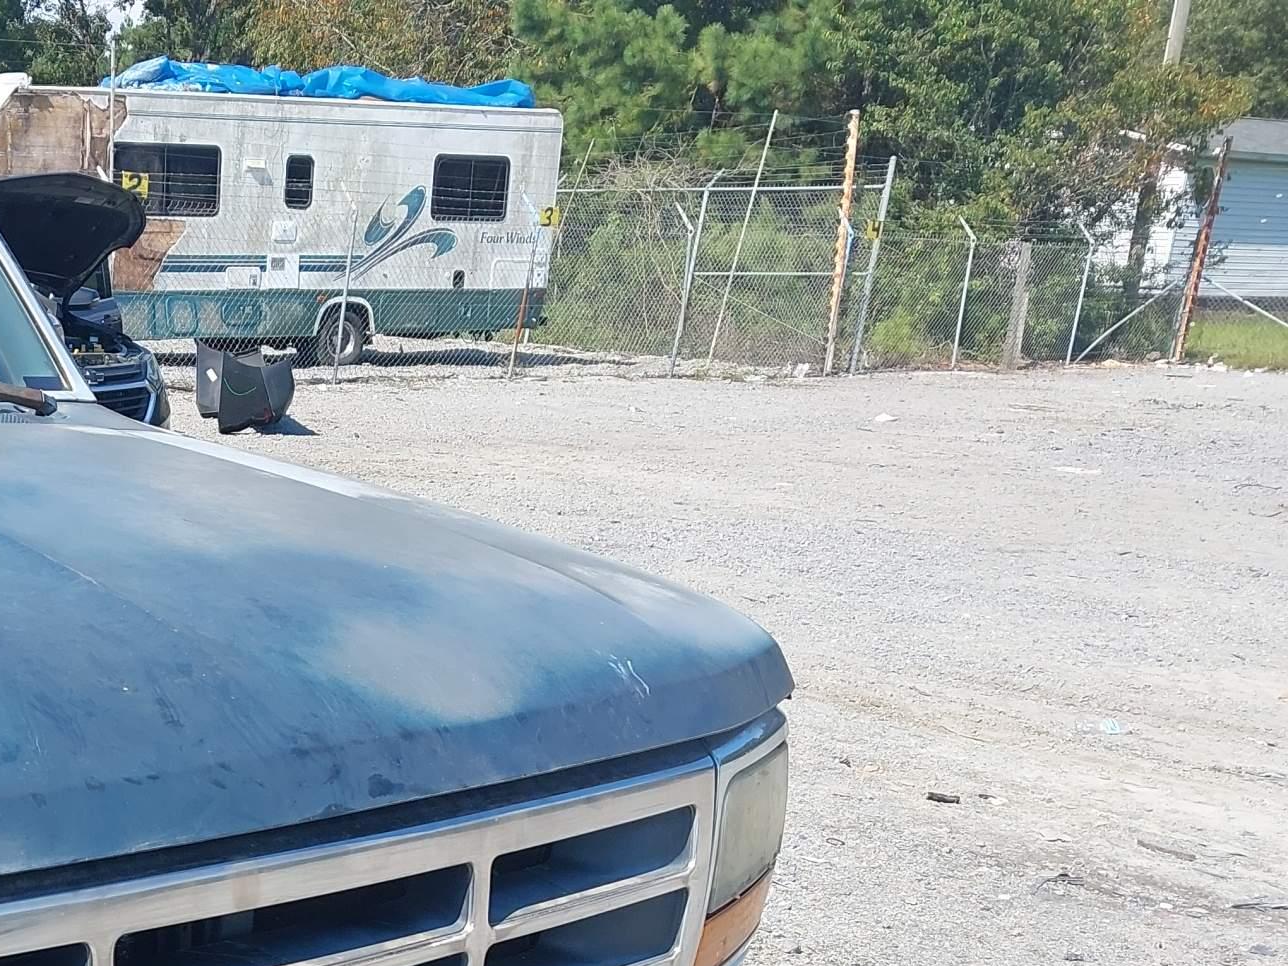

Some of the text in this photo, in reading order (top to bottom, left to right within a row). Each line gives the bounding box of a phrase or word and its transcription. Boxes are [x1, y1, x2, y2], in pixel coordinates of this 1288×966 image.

[127, 173, 142, 191] 2
[540, 206, 554, 227] 3
[479, 231, 537, 244] Four Winds
[871, 220, 881, 239] 4
